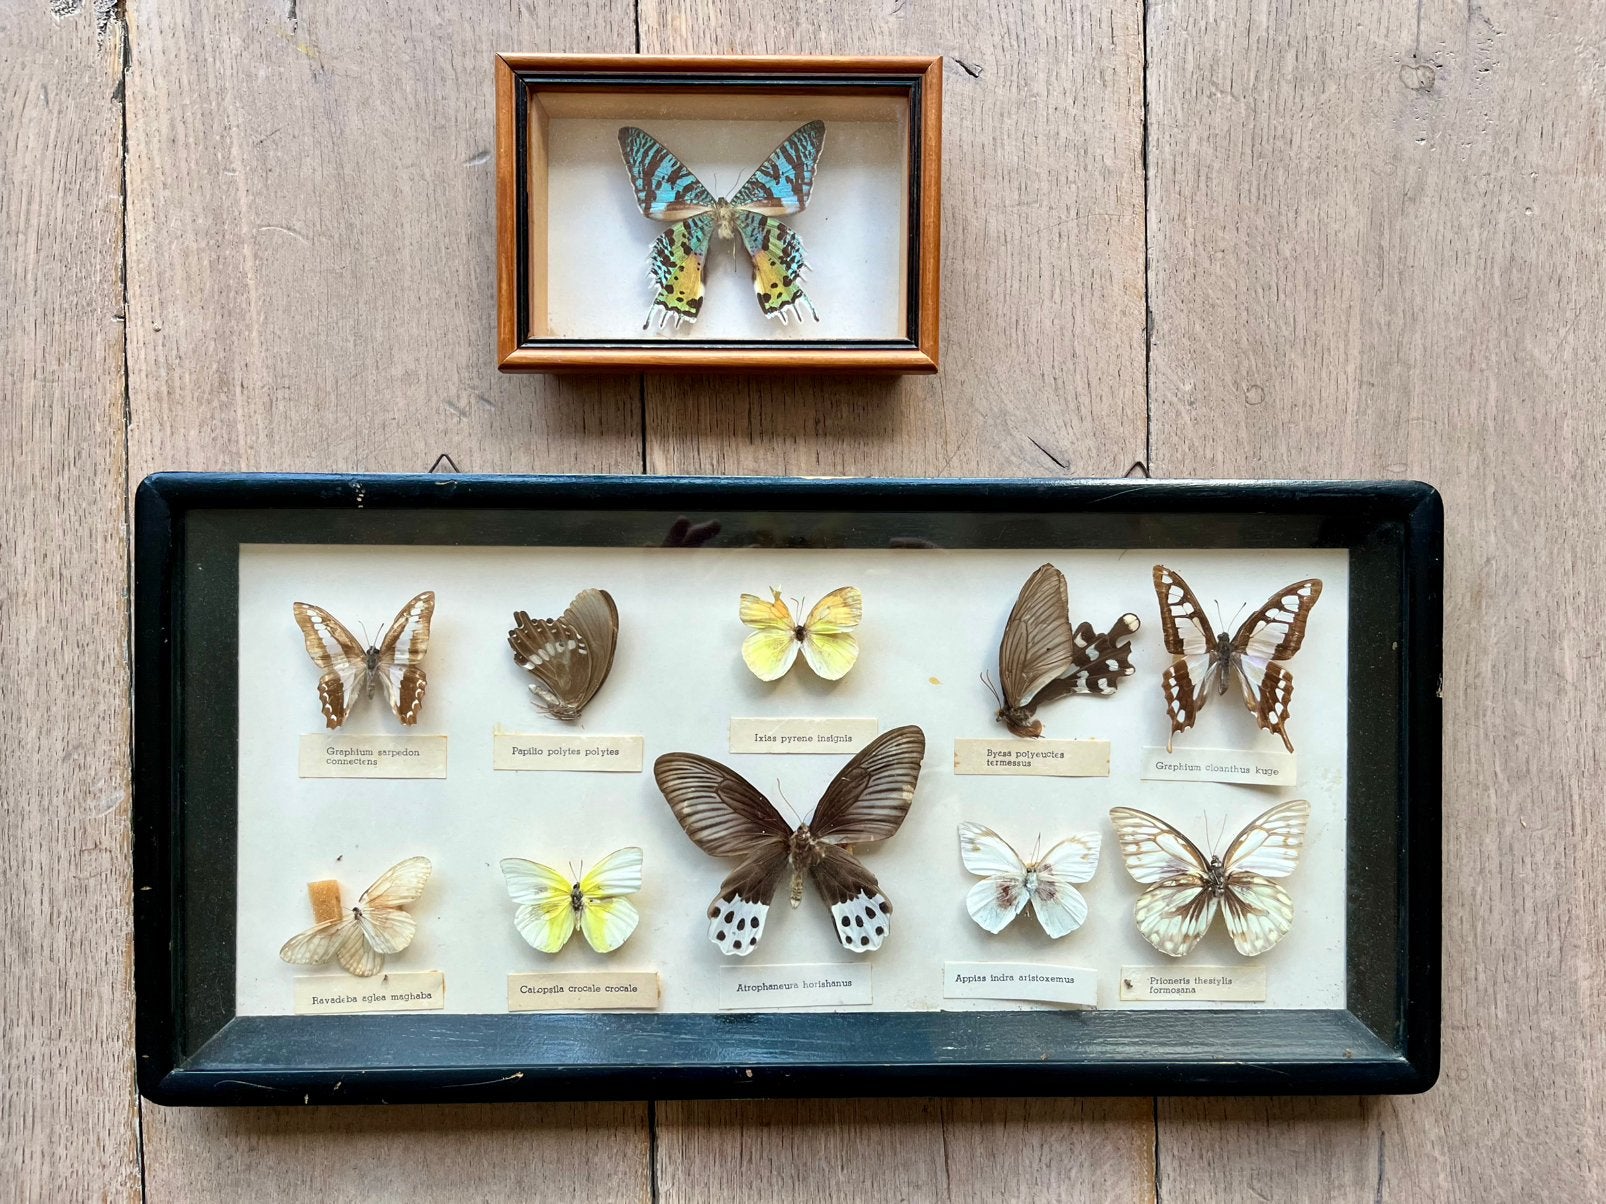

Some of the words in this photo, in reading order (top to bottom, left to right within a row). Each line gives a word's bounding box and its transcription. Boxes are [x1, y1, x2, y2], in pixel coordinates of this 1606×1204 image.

[754, 733, 777, 743] Ixias
[781, 735, 814, 744] pyrene
[817, 734, 853, 744] insignis
[326, 747, 374, 758] Graphium
[377, 747, 420, 758] sarpedon
[511, 747, 544, 758] Papilio
[547, 747, 581, 757] polytes
[585, 748, 620, 758] polytes
[1015, 750, 1065, 760] polyeuctes
[326, 758, 378, 766] connectens
[986, 759, 1032, 767] termessus
[1155, 762, 1202, 772] Graphium
[1205, 763, 1250, 774] cloanthus
[1255, 766, 1280, 777] kuge
[955, 974, 987, 984] Appias
[990, 973, 1015, 982] indra
[1018, 974, 1075, 984] aristoxemus
[1149, 976, 1191, 985] Prioneris
[568, 984, 601, 993] crocale
[604, 984, 638, 993] crocale
[736, 980, 799, 993] Atrophaneura
[802, 979, 853, 989] horishanus
[1149, 986, 1197, 995] formosana
[361, 992, 387, 1004] aglea
[391, 991, 433, 1003] maghaba
